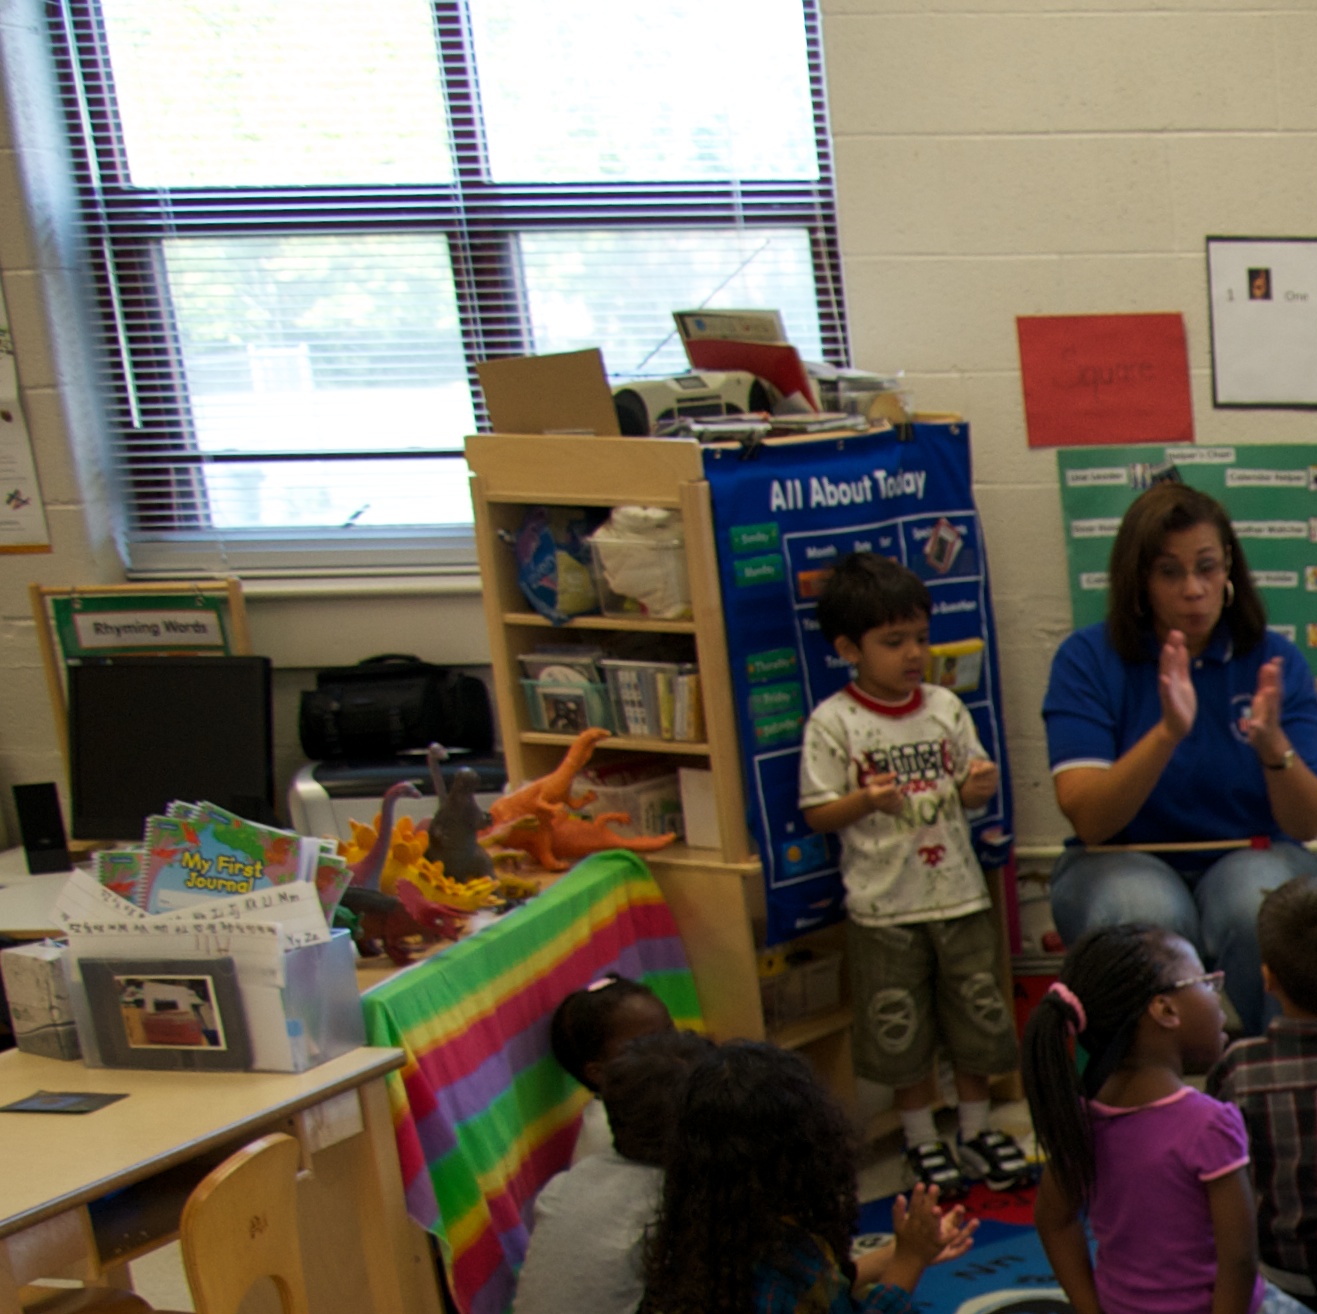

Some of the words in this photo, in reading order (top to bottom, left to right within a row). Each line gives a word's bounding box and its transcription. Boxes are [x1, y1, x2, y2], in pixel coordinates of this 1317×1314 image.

[770, 479, 803, 512] All
[809, 474, 873, 509] About
[873, 468, 927, 501] Today
[93, 621, 160, 637] Rhyming
[163, 620, 208, 634] Words
[181, 851, 210, 876] My
[217, 856, 264, 878] First
[185, 871, 255, 894] Journal
